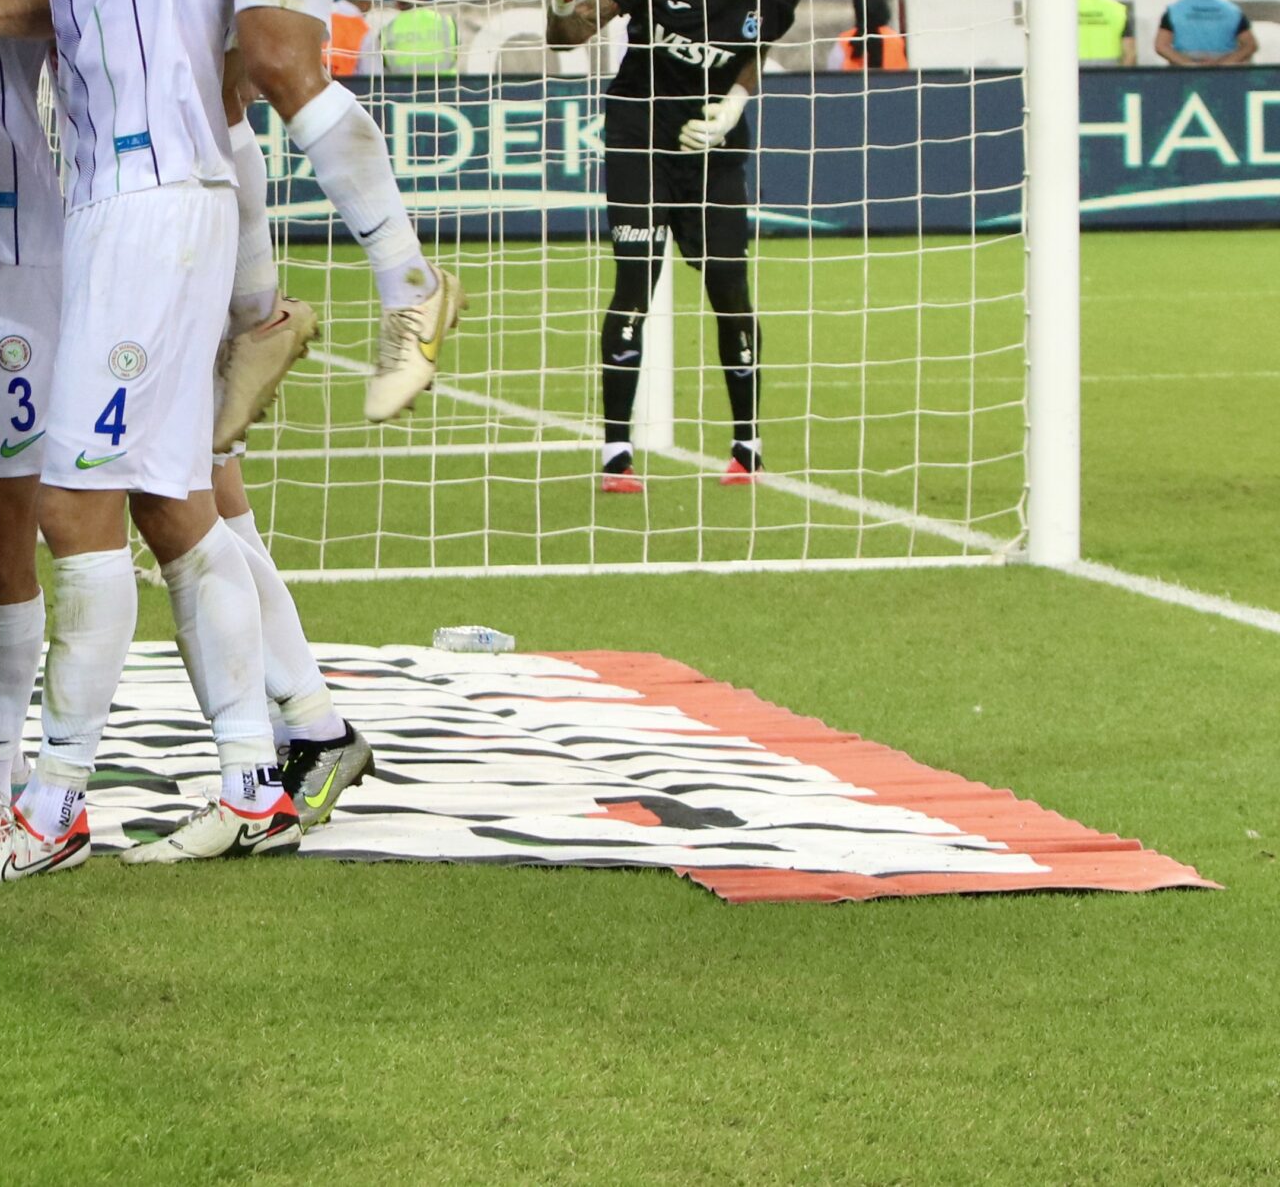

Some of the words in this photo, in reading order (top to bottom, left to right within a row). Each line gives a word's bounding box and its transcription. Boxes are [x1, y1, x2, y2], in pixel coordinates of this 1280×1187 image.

[8, 377, 36, 432] 3
[94, 387, 127, 445] 4
[59, 789, 77, 827] ESIGN
